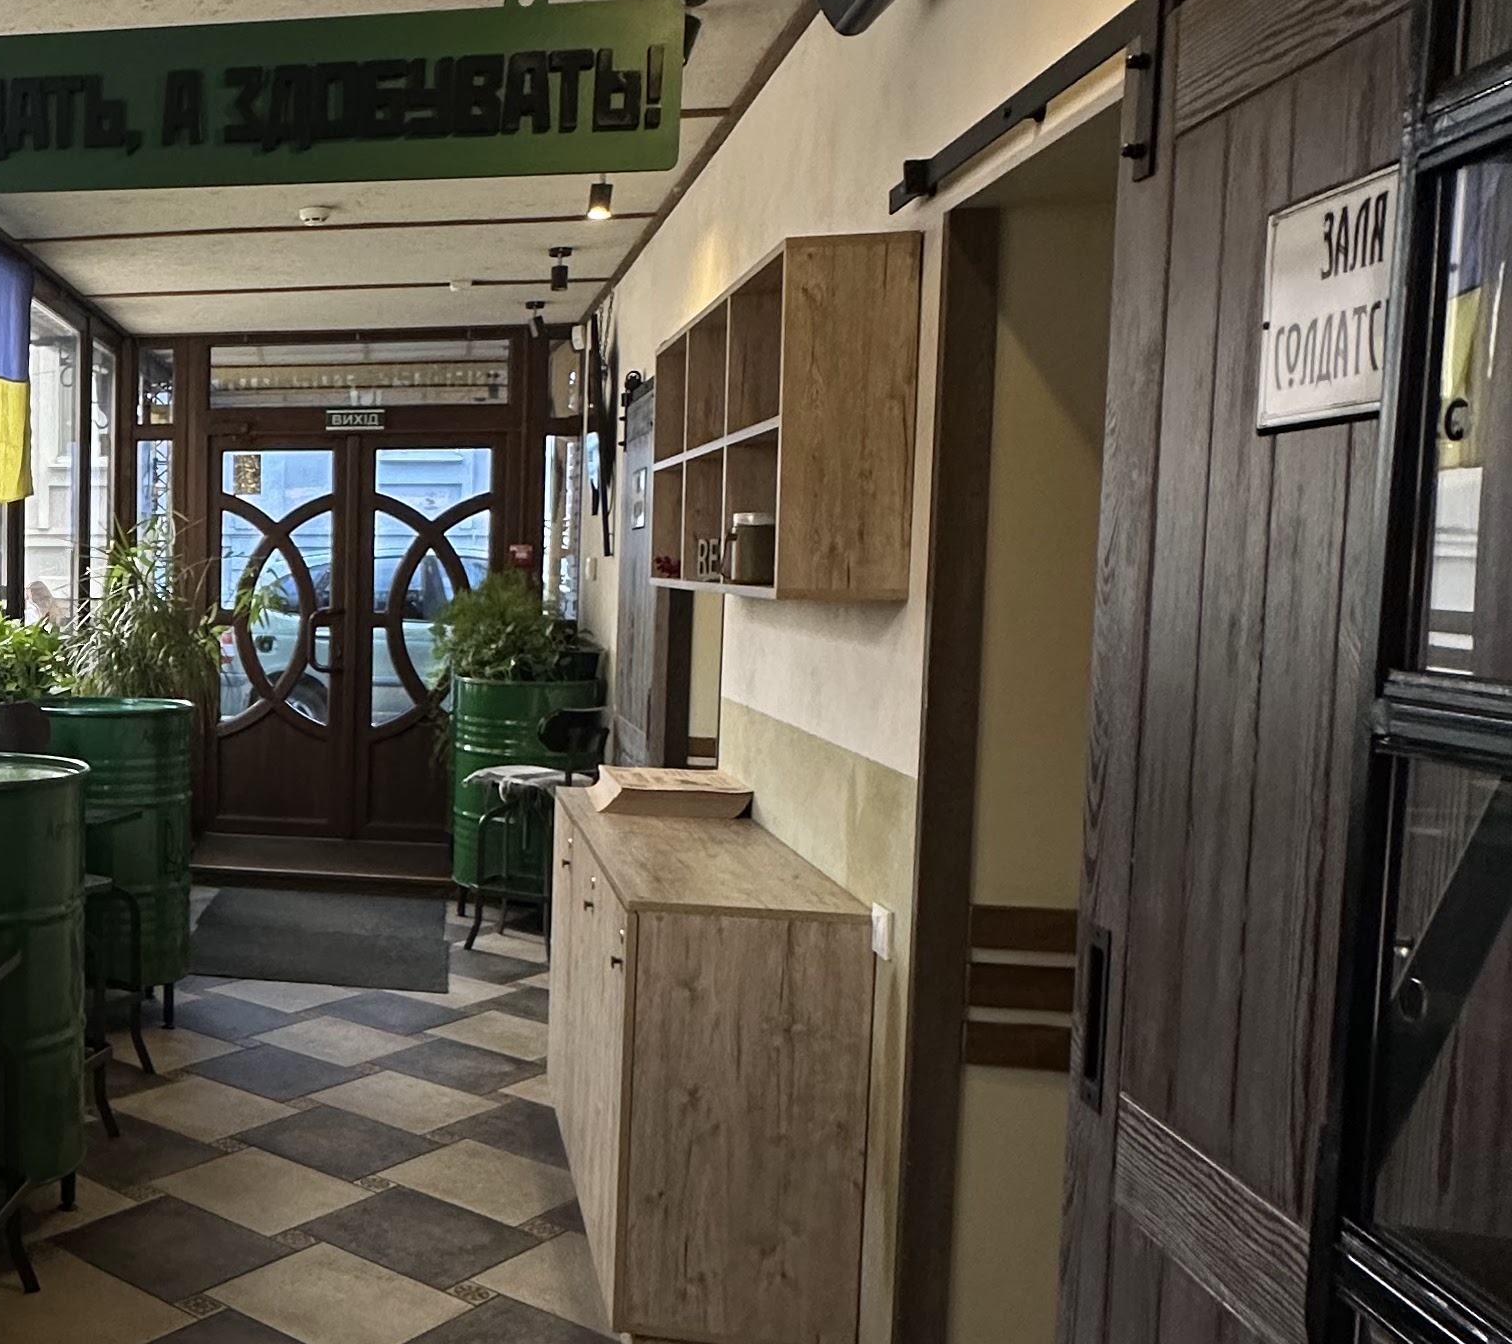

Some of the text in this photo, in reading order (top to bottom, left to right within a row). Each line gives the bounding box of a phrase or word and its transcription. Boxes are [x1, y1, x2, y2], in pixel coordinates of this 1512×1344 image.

[160, 68, 205, 146] А
[222, 45, 665, 154] ЗДОБУВАТЬ!
[1321, 191, 1389, 280] ЗАЛЯ
[1274, 298, 1390, 391] СОЛДАТС
[331, 414, 379, 425] ВИХІД
